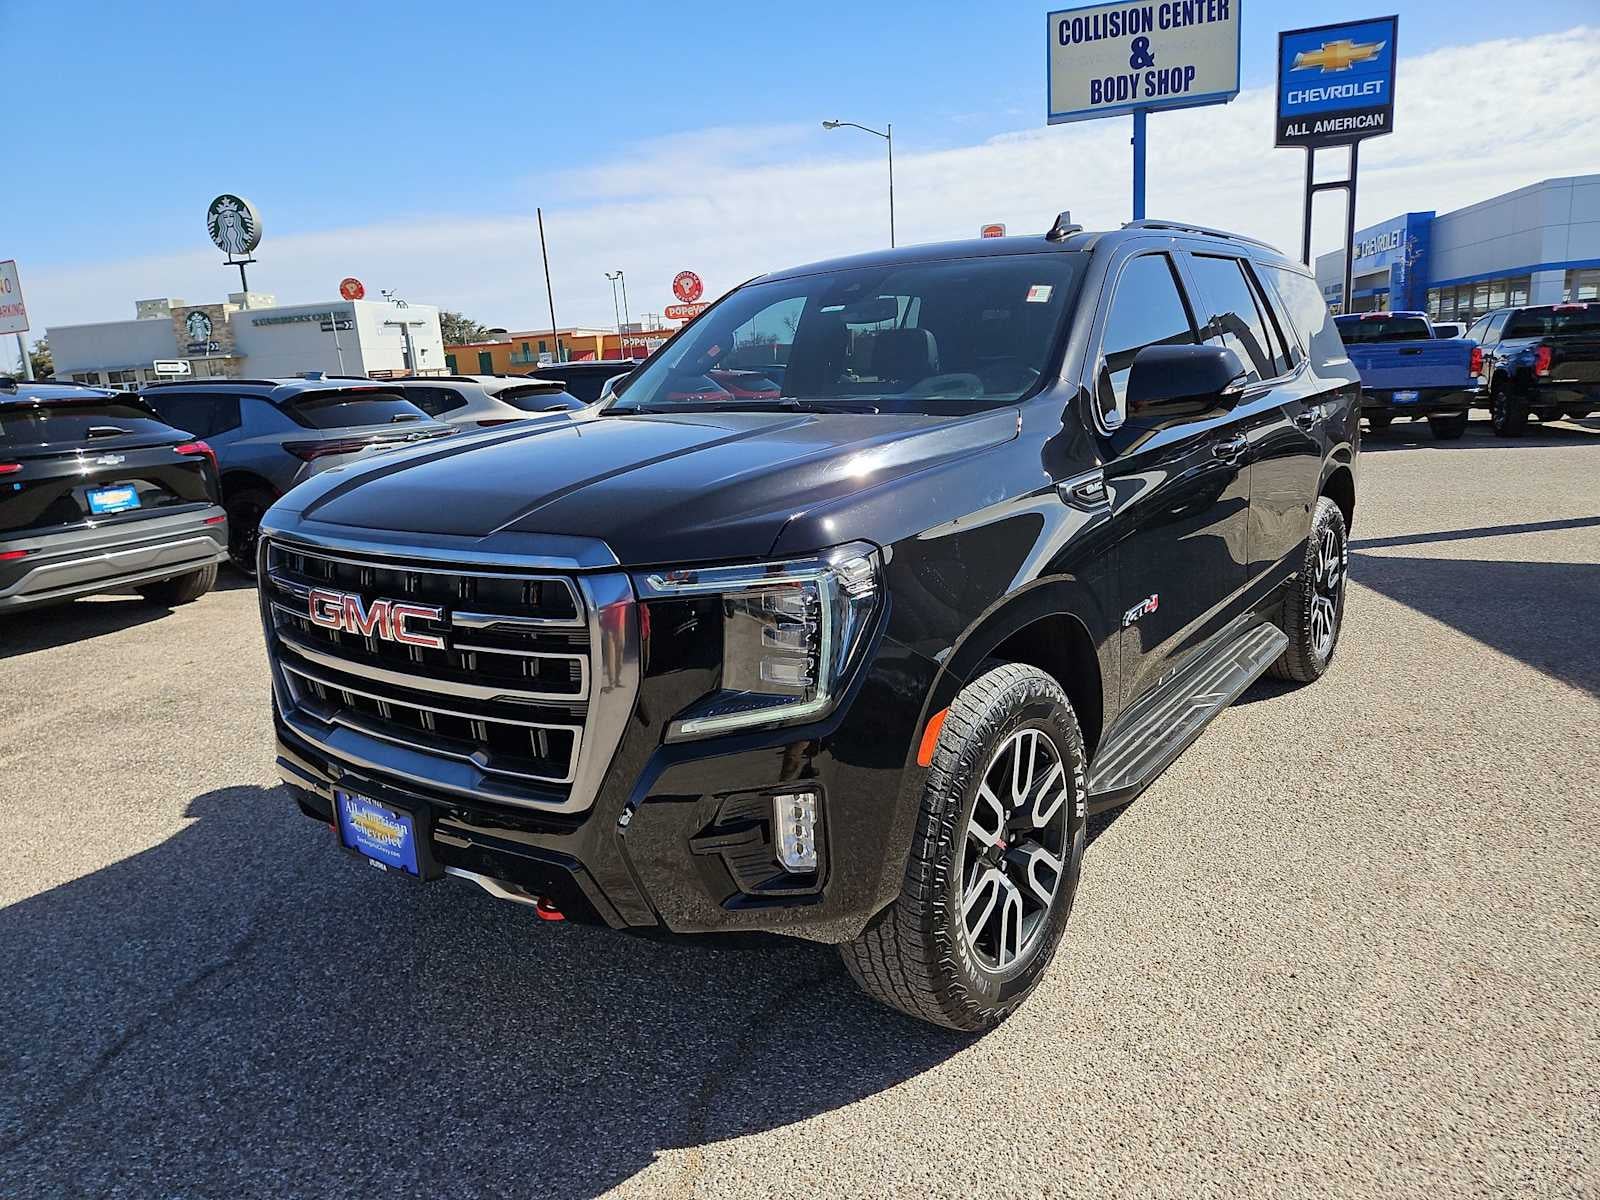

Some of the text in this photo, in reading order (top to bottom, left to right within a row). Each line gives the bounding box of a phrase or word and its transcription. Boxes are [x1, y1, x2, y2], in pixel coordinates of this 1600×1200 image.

[1058, 6, 1153, 46] COLLISION
[1158, 0, 1229, 30] CENTER
[1129, 36, 1154, 70] &
[1090, 66, 1195, 104] BODY SHOP
[1287, 80, 1384, 104] CHEVROLET
[1285, 113, 1384, 136] ALL AMERICAN
[1361, 229, 1402, 257] CHEVROLET
[308, 586, 446, 650] GMC
